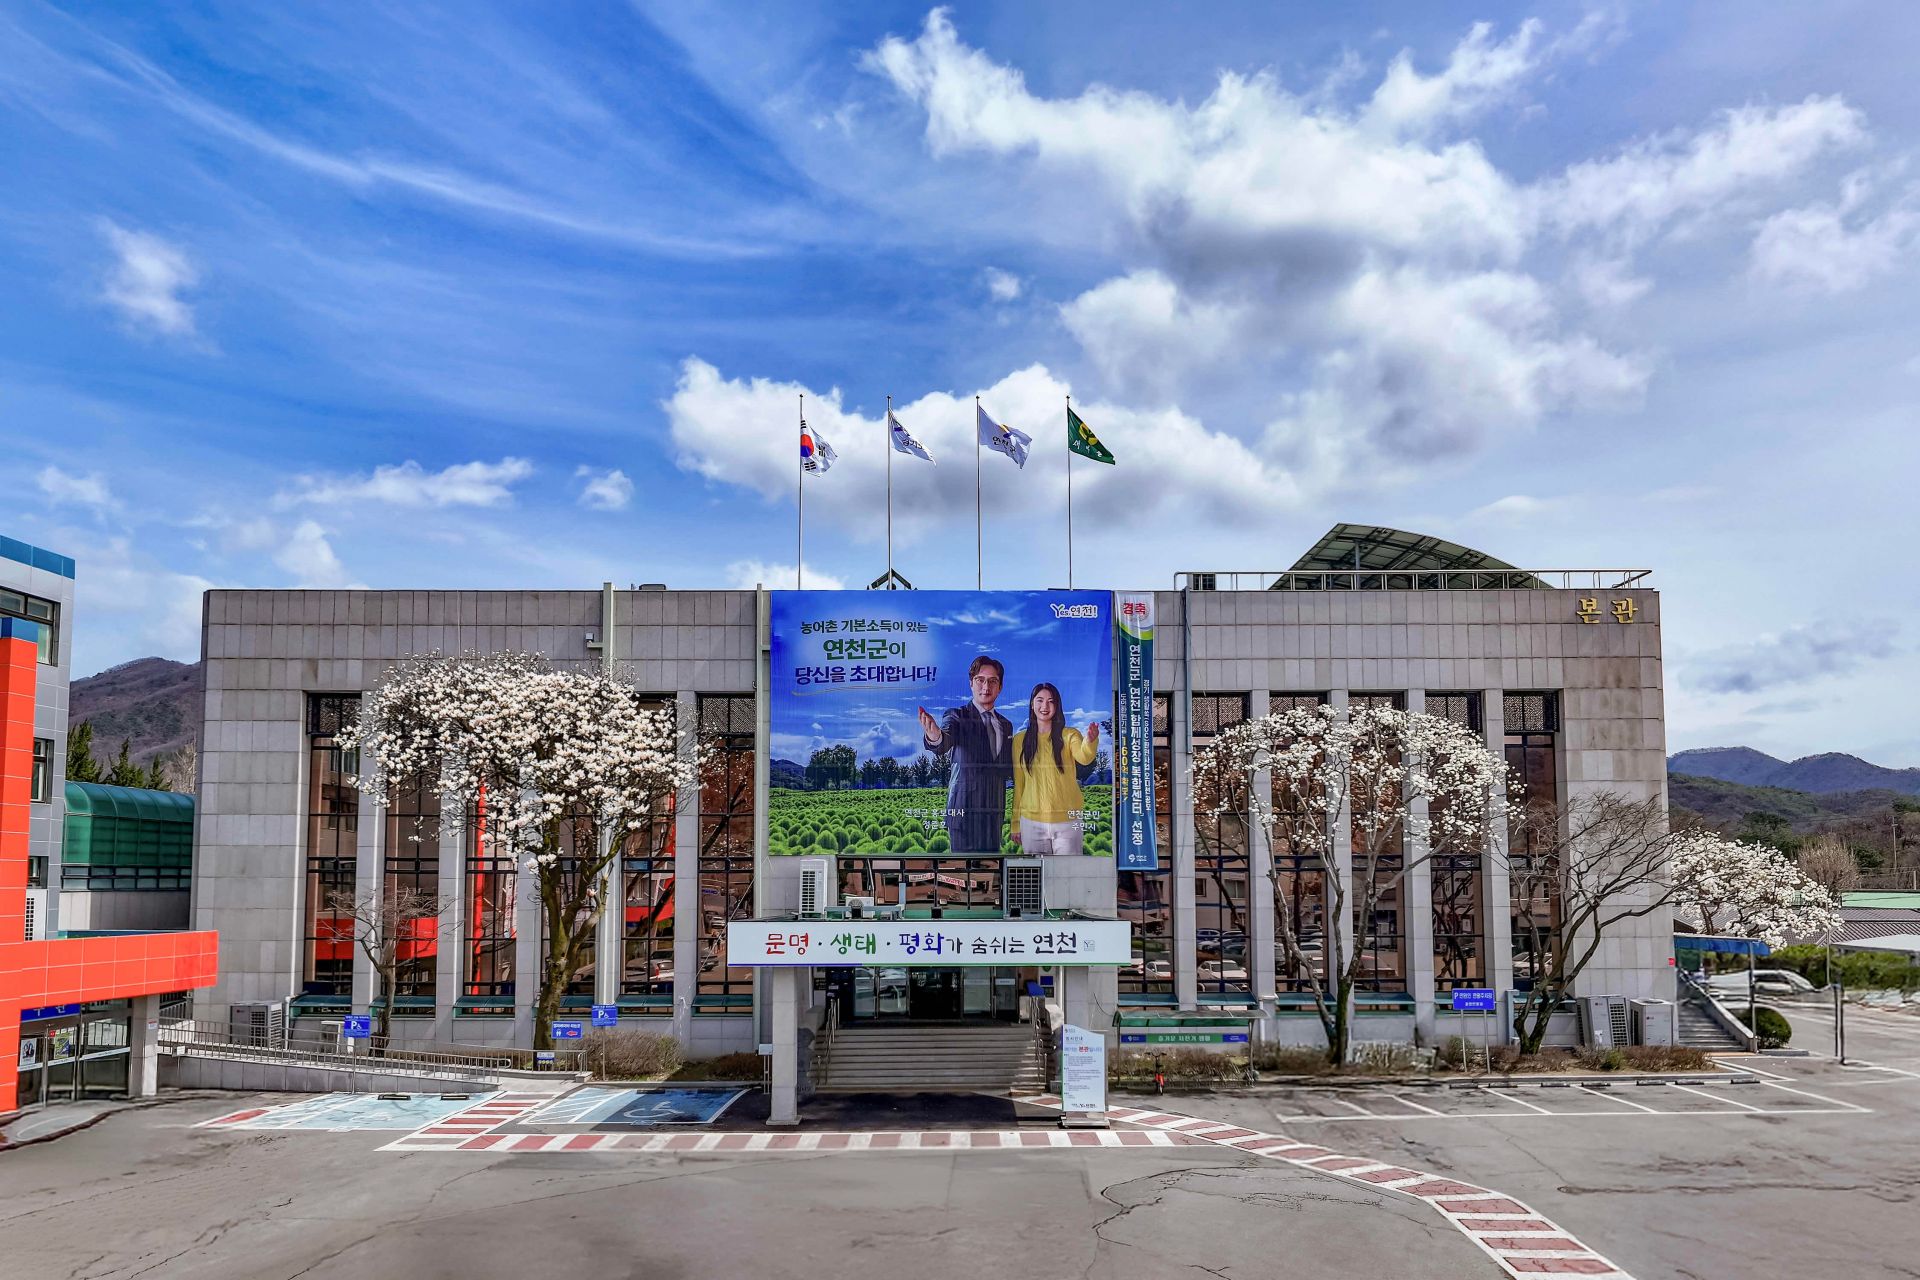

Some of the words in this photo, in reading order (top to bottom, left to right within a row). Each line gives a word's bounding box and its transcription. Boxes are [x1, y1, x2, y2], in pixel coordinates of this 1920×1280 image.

[1123, 602, 1146, 615] 경축
[1576, 597, 1639, 624] 본관
[800, 619, 838, 635] 농어촌
[841, 618, 903, 633] 기본소득이
[906, 621, 929, 633] 있는
[823, 638, 906, 660] 연천군이
[1129, 644, 1141, 681] 연천군
[795, 666, 846, 685] 당신을
[850, 665, 937, 683] 초대합니다!
[904, 808, 928, 818] 연천군
[931, 808, 965, 818] 홍보대사
[1067, 810, 1101, 820] 연천군민
[1131, 820, 1143, 846] 선정
[765, 933, 810, 955] 문명
[830, 933, 876, 955] 생태
[899, 932, 963, 955] 평화가
[971, 937, 1025, 955] 숨쉬는
[1033, 932, 1077, 954] 연천
[598, 1010, 604, 1018] P
[351, 1021, 357, 1029] P
